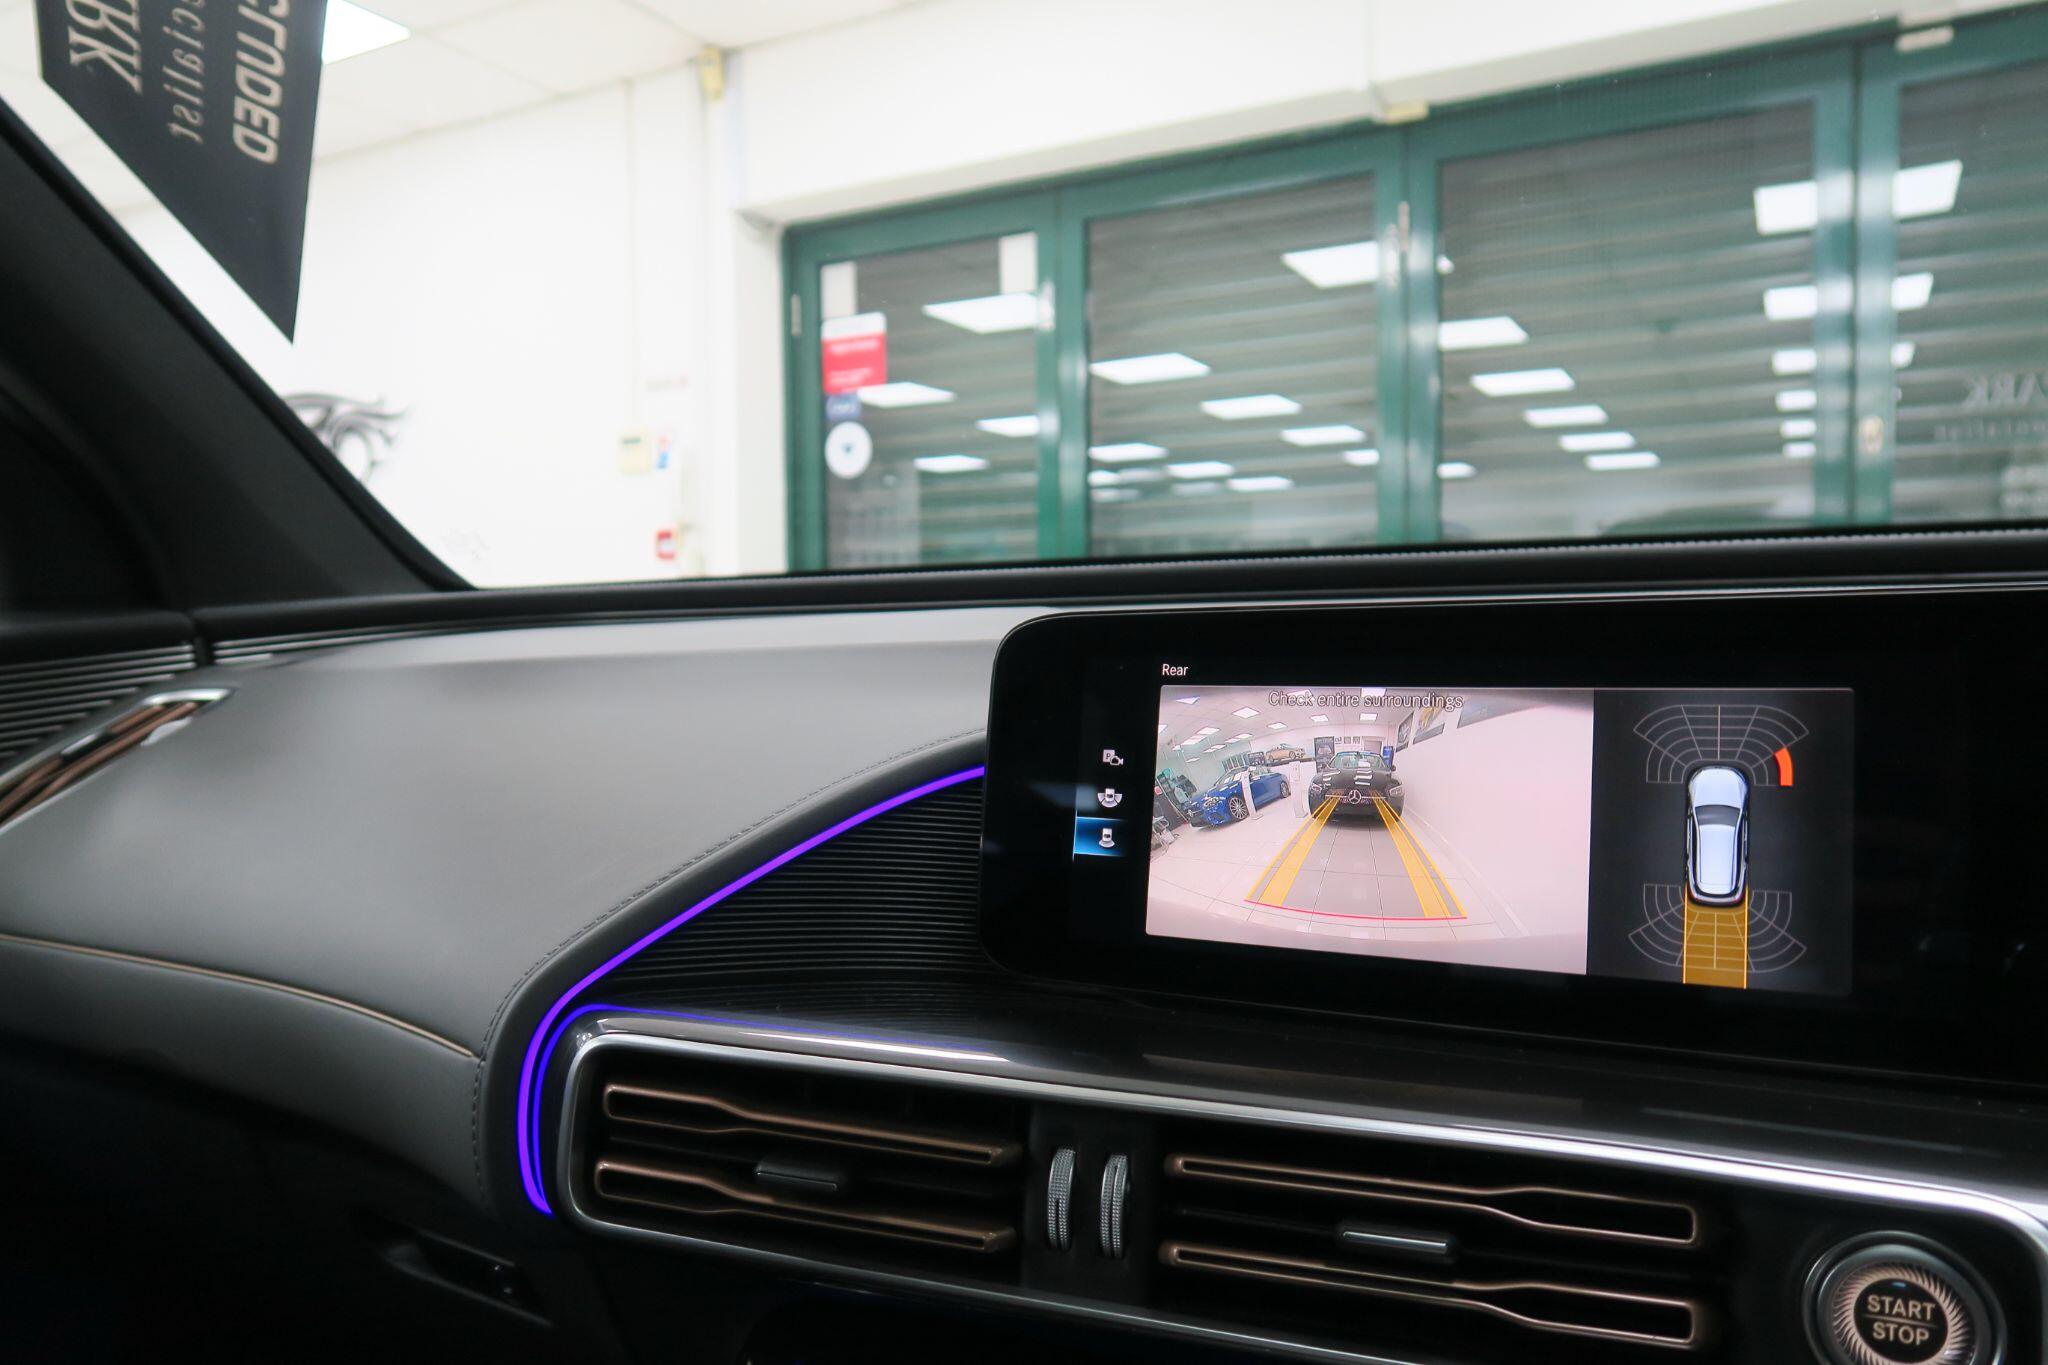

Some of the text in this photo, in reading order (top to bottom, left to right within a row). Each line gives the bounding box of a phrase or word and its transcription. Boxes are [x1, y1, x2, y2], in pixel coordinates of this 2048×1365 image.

[1162, 664, 1189, 676] Rear
[1269, 691, 1464, 713] Check entire surroundings
[1867, 1294, 1936, 1320] START
[1872, 1321, 1930, 1346] STOP
